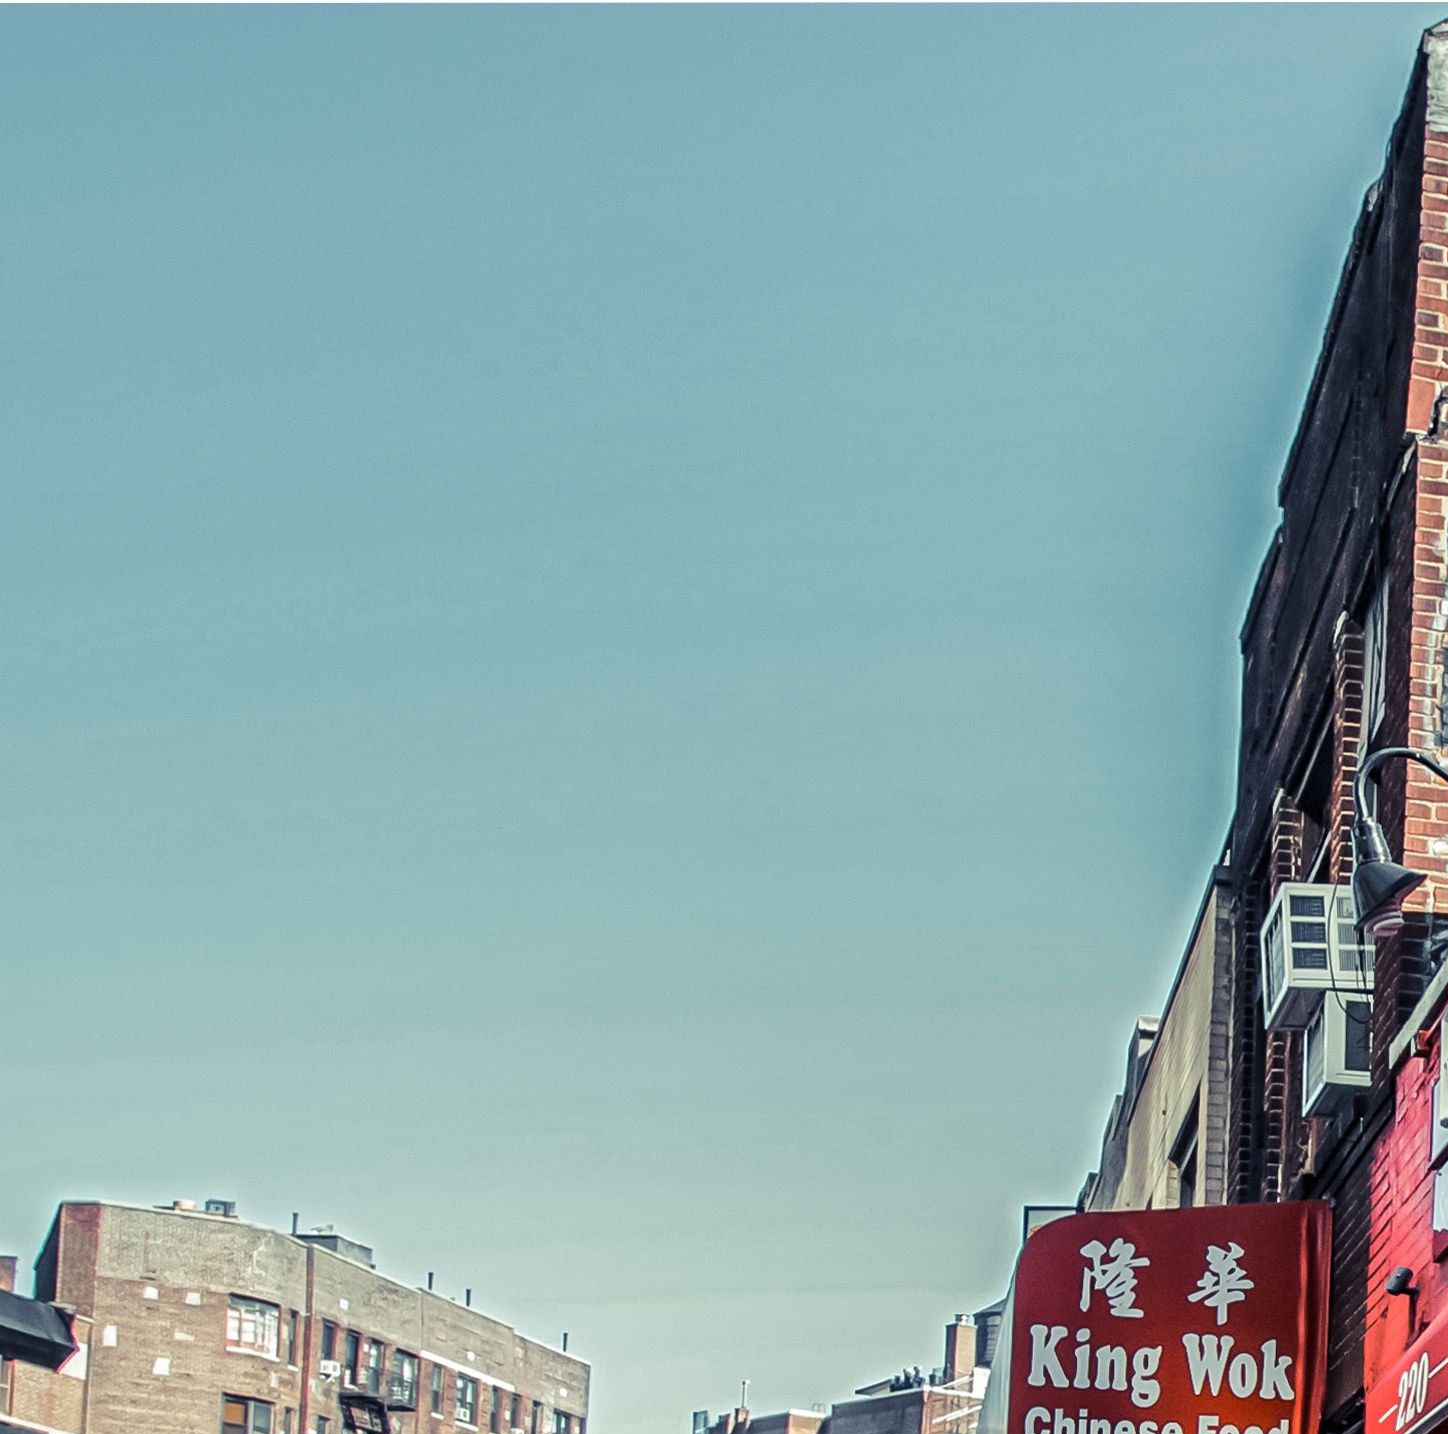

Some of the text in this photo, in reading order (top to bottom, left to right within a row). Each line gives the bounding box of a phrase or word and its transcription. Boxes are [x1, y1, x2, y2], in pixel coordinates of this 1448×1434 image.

[1027, 1323, 1296, 1408] King Wok
[1394, 1351, 1429, 1432] 220
